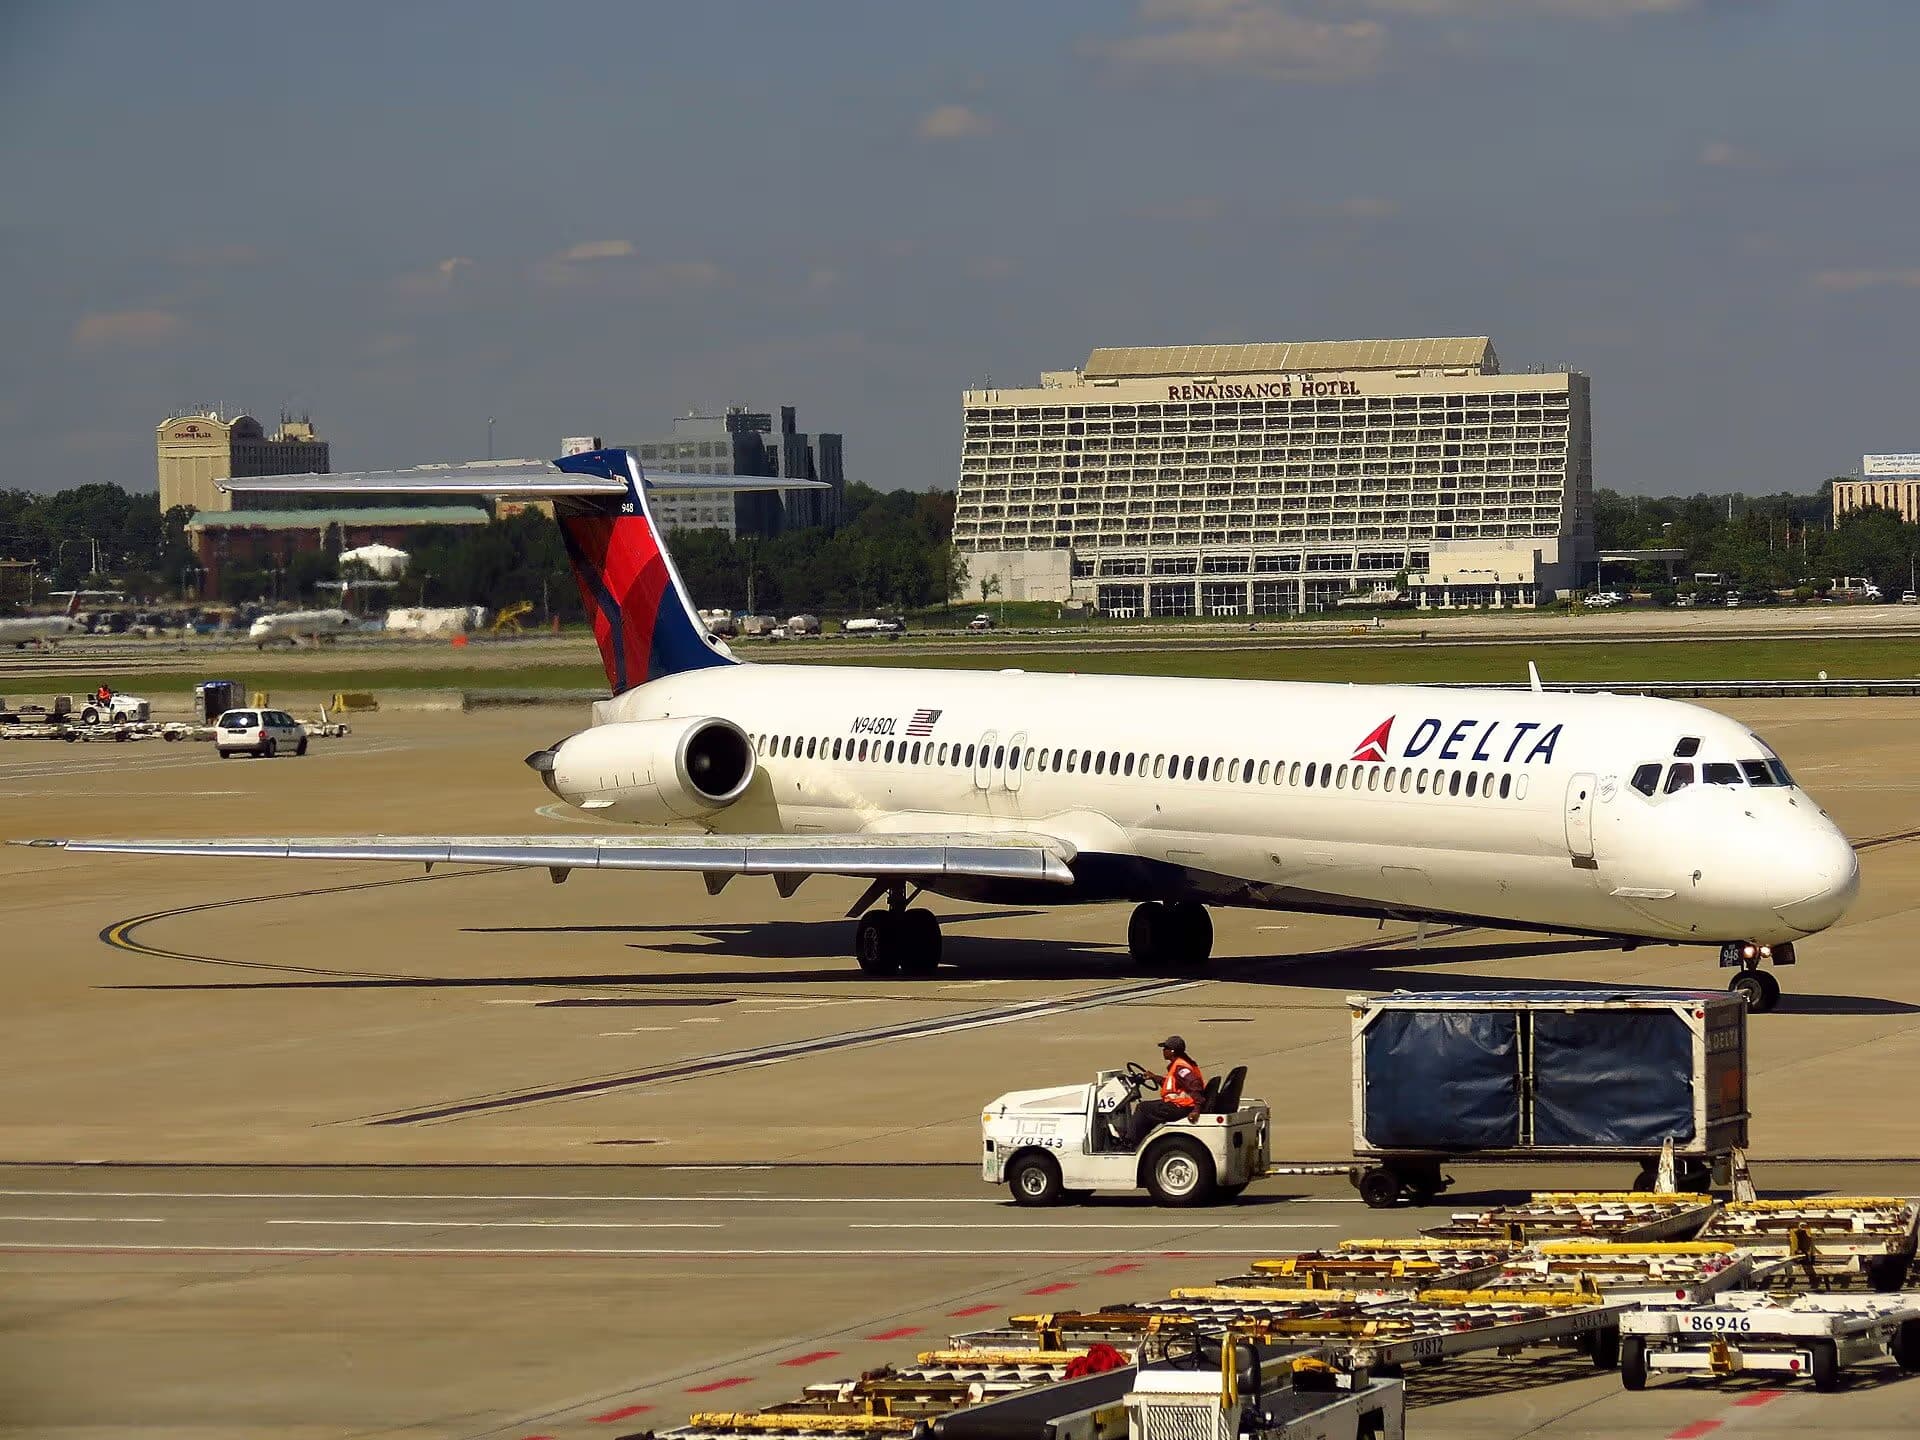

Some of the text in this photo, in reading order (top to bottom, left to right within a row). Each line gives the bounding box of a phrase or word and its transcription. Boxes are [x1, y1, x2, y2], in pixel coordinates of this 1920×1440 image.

[1168, 380, 1360, 400] RENAISSANCE HOTEL
[621, 503, 634, 513] 948
[850, 716, 897, 735] N948DL
[1402, 718, 1564, 764] DELTA
[1723, 949, 1739, 961] 948
[1099, 1097, 1115, 1109] 46
[1692, 1316, 1751, 1331] 86946
[1412, 1338, 1443, 1357] 94812
